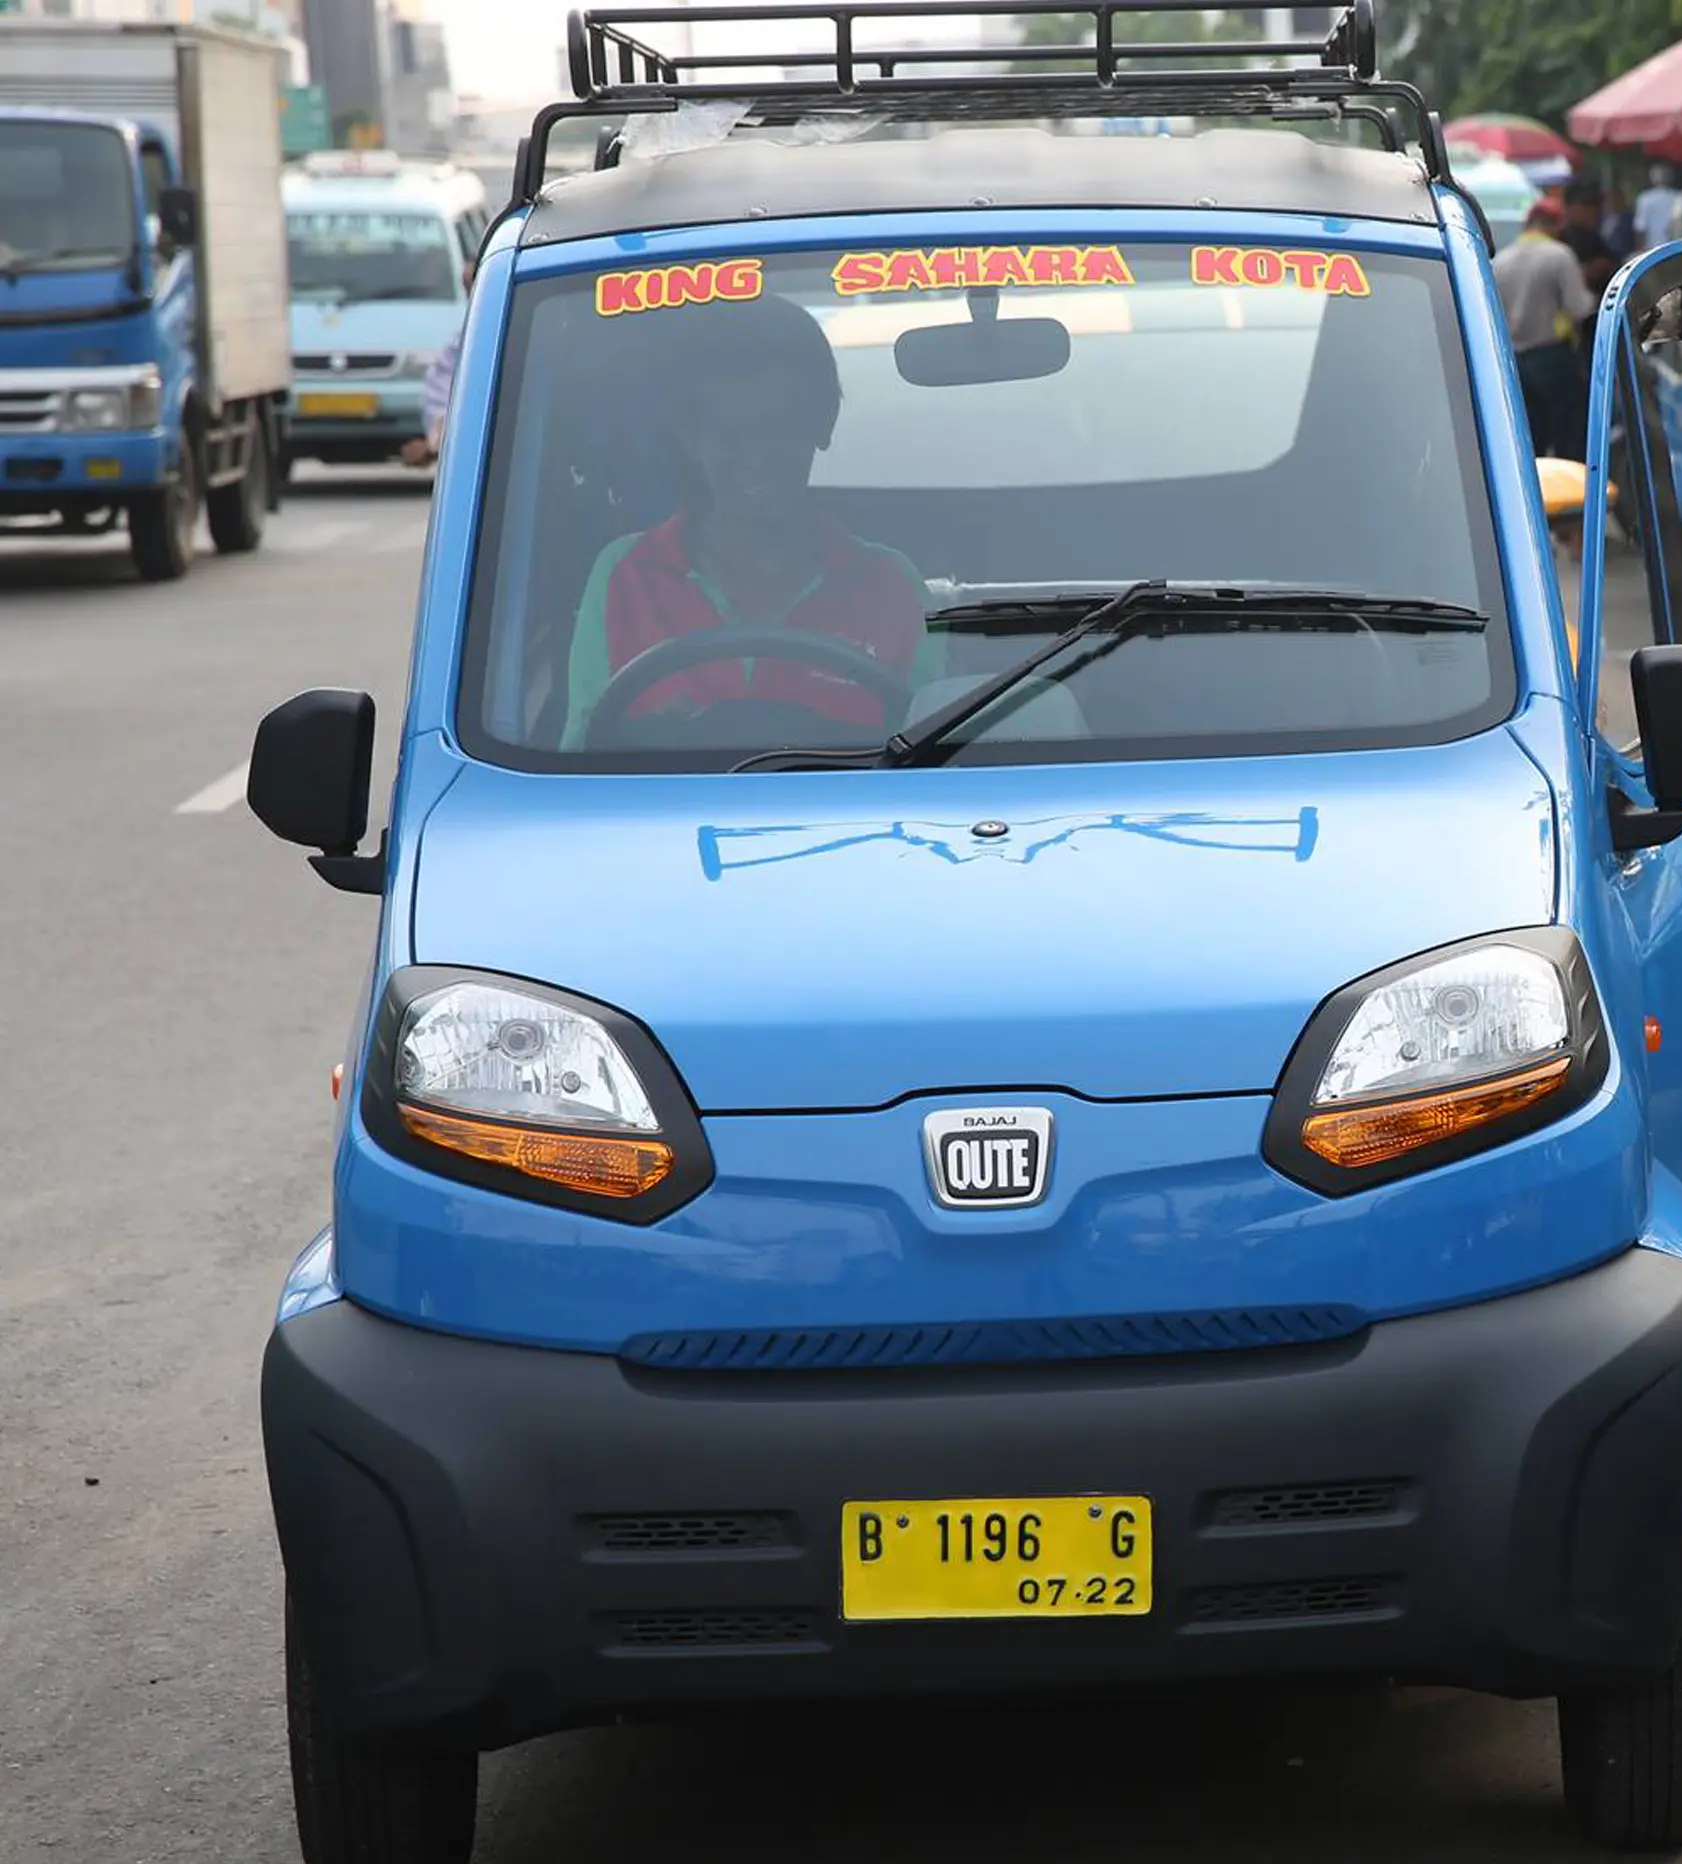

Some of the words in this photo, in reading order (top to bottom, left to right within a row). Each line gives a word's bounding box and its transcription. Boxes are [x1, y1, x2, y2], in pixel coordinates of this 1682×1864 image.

[596, 259, 763, 316] KING
[831, 246, 1135, 295] SAHARA
[1192, 247, 1371, 296] KOTA
[963, 1116, 1018, 1127] BAJAJ
[947, 1138, 1031, 1190] QUTE
[858, 1512, 883, 1562] B
[936, 1512, 1043, 1562] 1196
[1110, 1510, 1137, 1559] G
